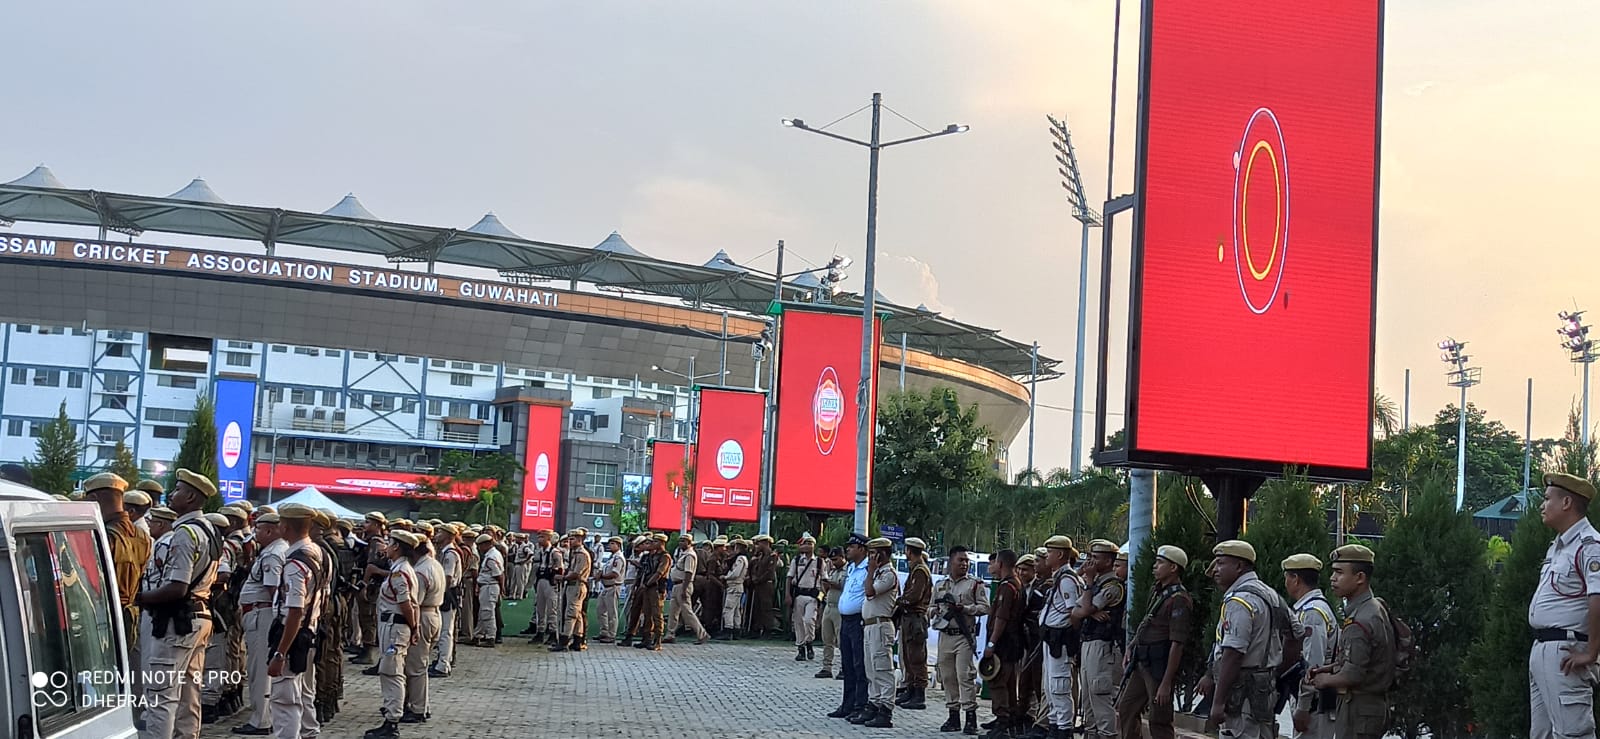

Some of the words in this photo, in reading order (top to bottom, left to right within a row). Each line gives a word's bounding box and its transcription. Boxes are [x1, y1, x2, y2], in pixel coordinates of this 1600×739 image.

[73, 242, 170, 265] CRICKET
[187, 253, 333, 281] ASSOCIATION
[348, 269, 445, 295] STADIUM,
[460, 281, 559, 307] GUWAHATI
